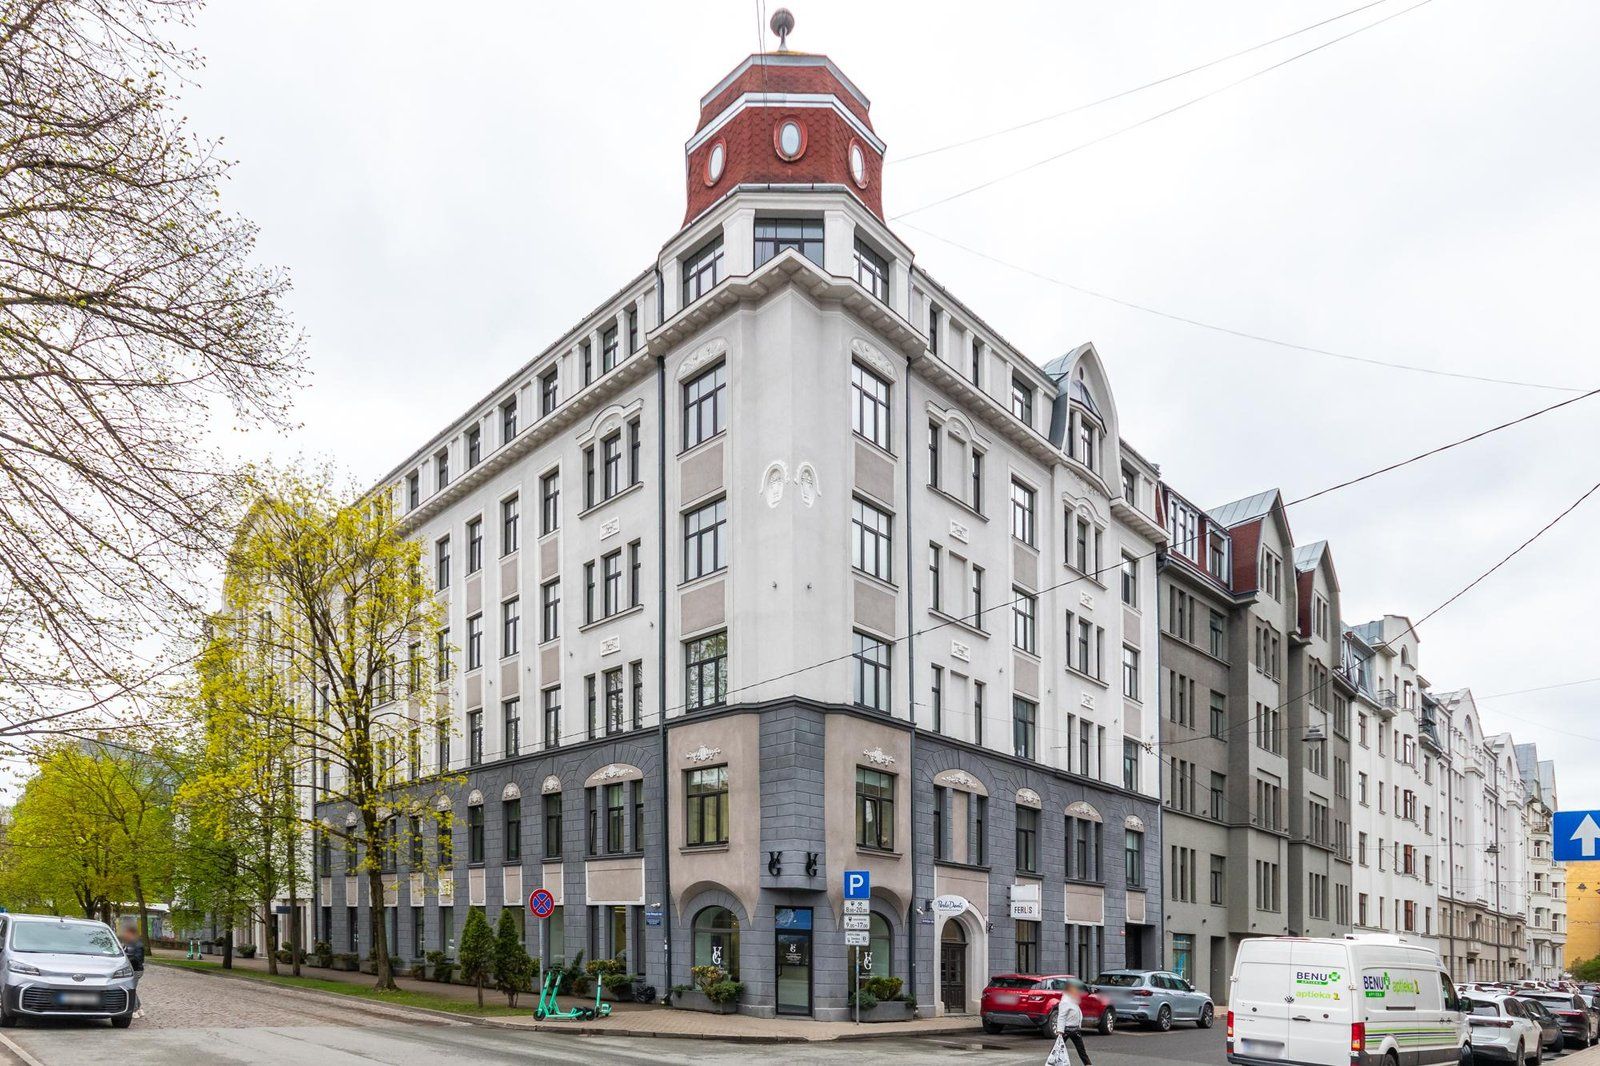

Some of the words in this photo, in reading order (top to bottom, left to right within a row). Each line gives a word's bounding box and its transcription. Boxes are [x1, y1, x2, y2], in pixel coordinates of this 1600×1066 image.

[849, 874, 864, 896] P
[1296, 971, 1328, 982] BENU
[1363, 976, 1384, 990] BENU
